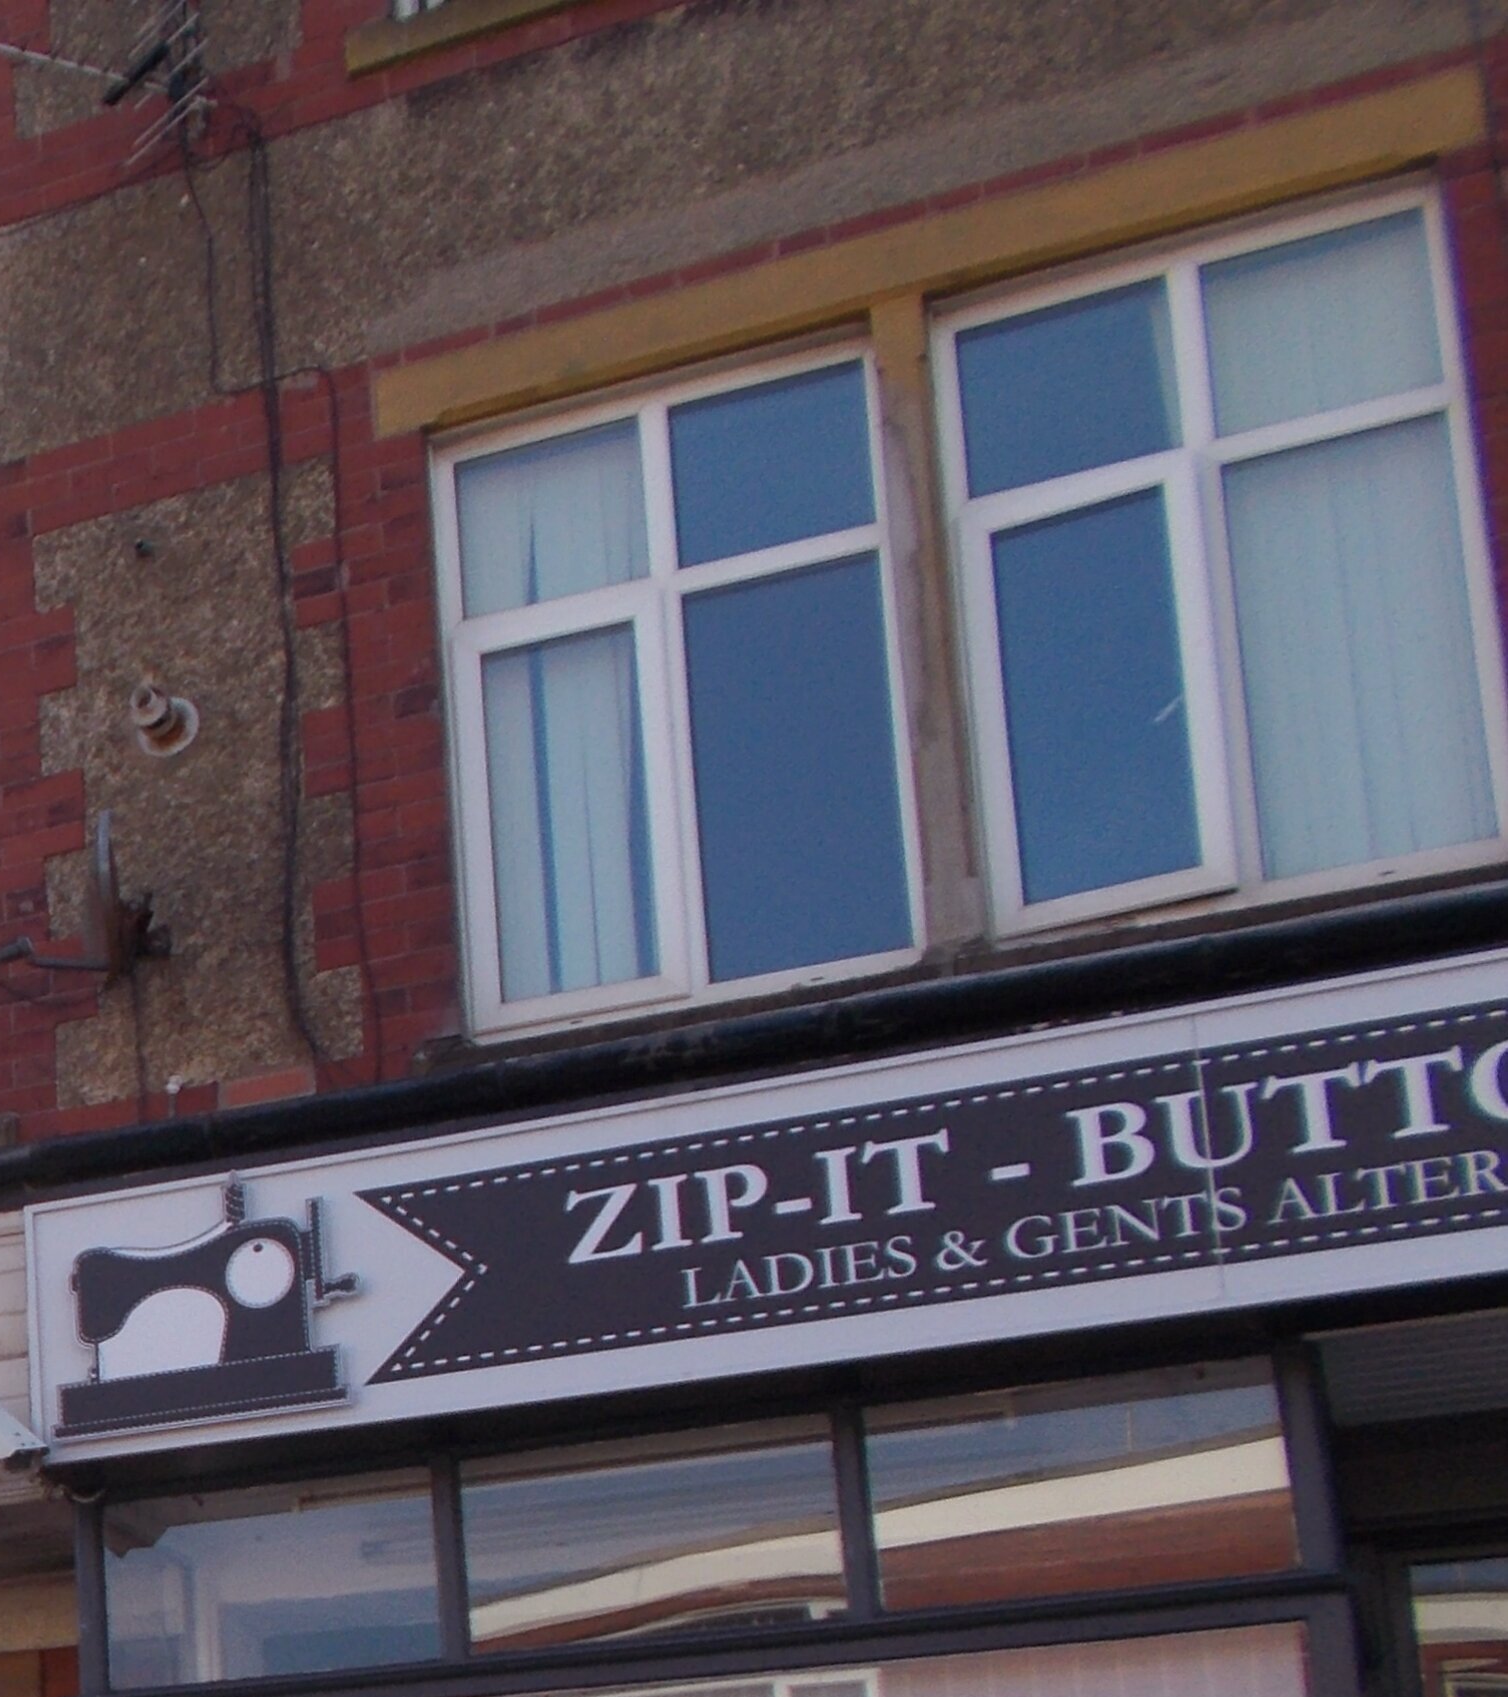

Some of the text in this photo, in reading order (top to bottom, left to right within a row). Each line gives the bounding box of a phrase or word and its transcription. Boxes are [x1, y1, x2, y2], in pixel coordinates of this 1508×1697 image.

[565, 1128, 950, 1264] ZIP-IT
[680, 1149, 1508, 1310] LADIES & GENTS ALTER
